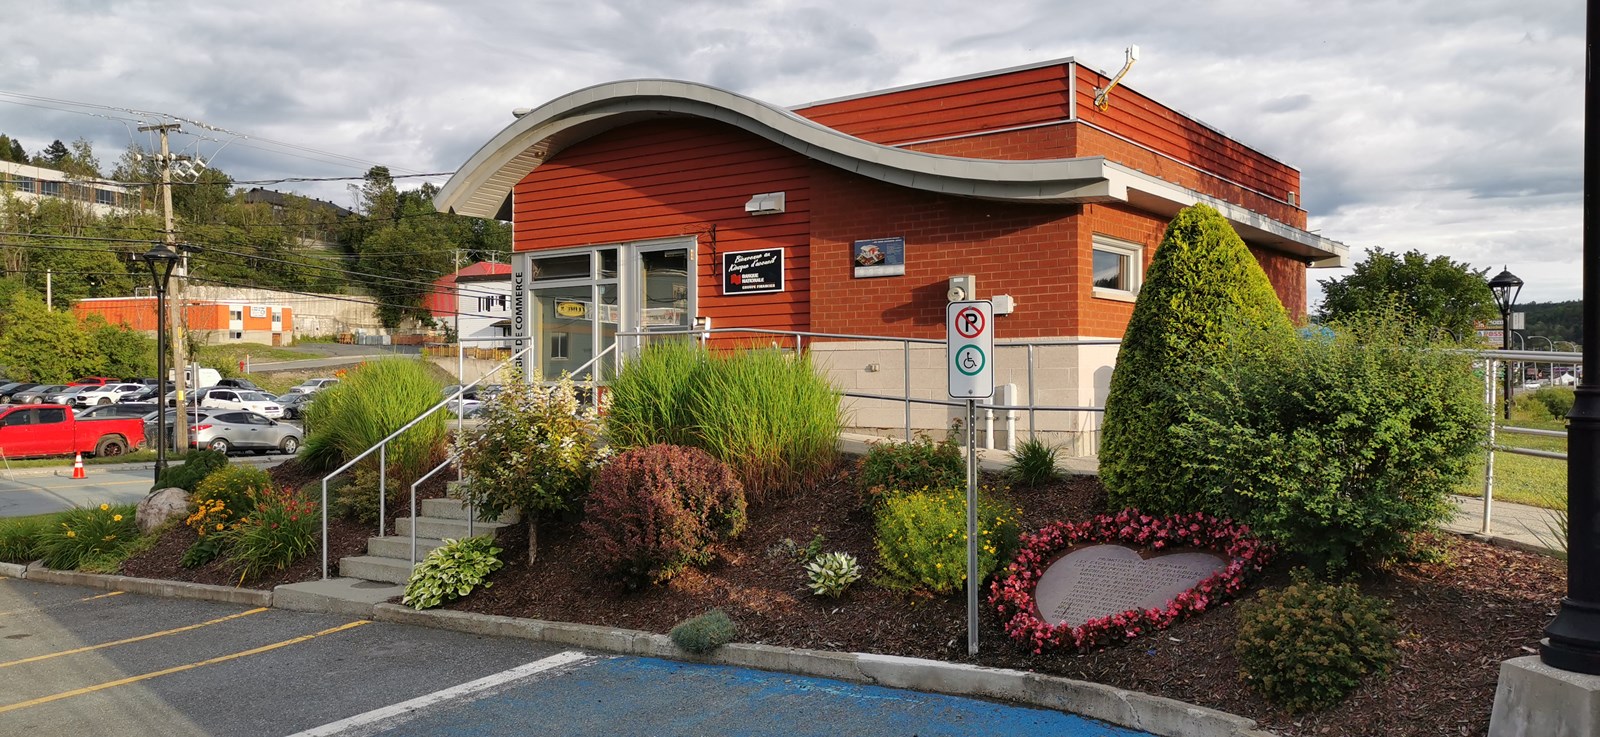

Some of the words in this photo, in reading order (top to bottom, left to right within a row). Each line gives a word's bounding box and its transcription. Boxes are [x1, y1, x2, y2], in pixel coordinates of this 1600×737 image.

[728, 264, 749, 273] Kiosque
[750, 256, 777, 268] d'accueil
[734, 254, 762, 264] Bienvenue
[515, 271, 523, 331] COMMERCE
[965, 313, 978, 333] P
[515, 332, 523, 346] DE
